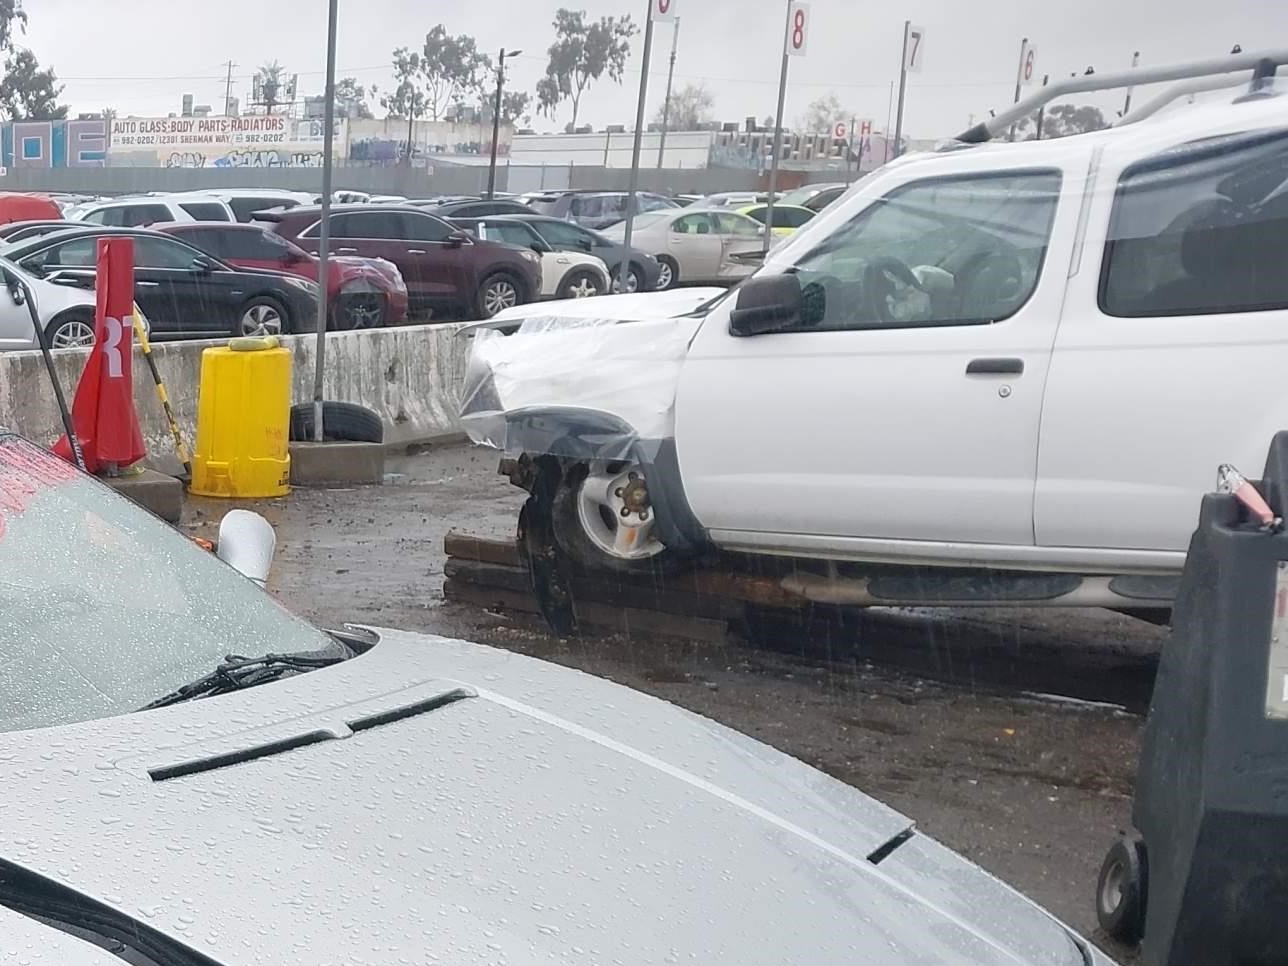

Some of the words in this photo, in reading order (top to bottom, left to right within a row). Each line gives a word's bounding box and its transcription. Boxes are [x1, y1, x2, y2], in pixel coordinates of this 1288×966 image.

[793, 9, 804, 49] 8
[910, 32, 921, 66] 7
[1024, 50, 1034, 80] 6
[114, 121, 137, 134] AUTO
[835, 122, 846, 137] G
[861, 121, 871, 135] H
